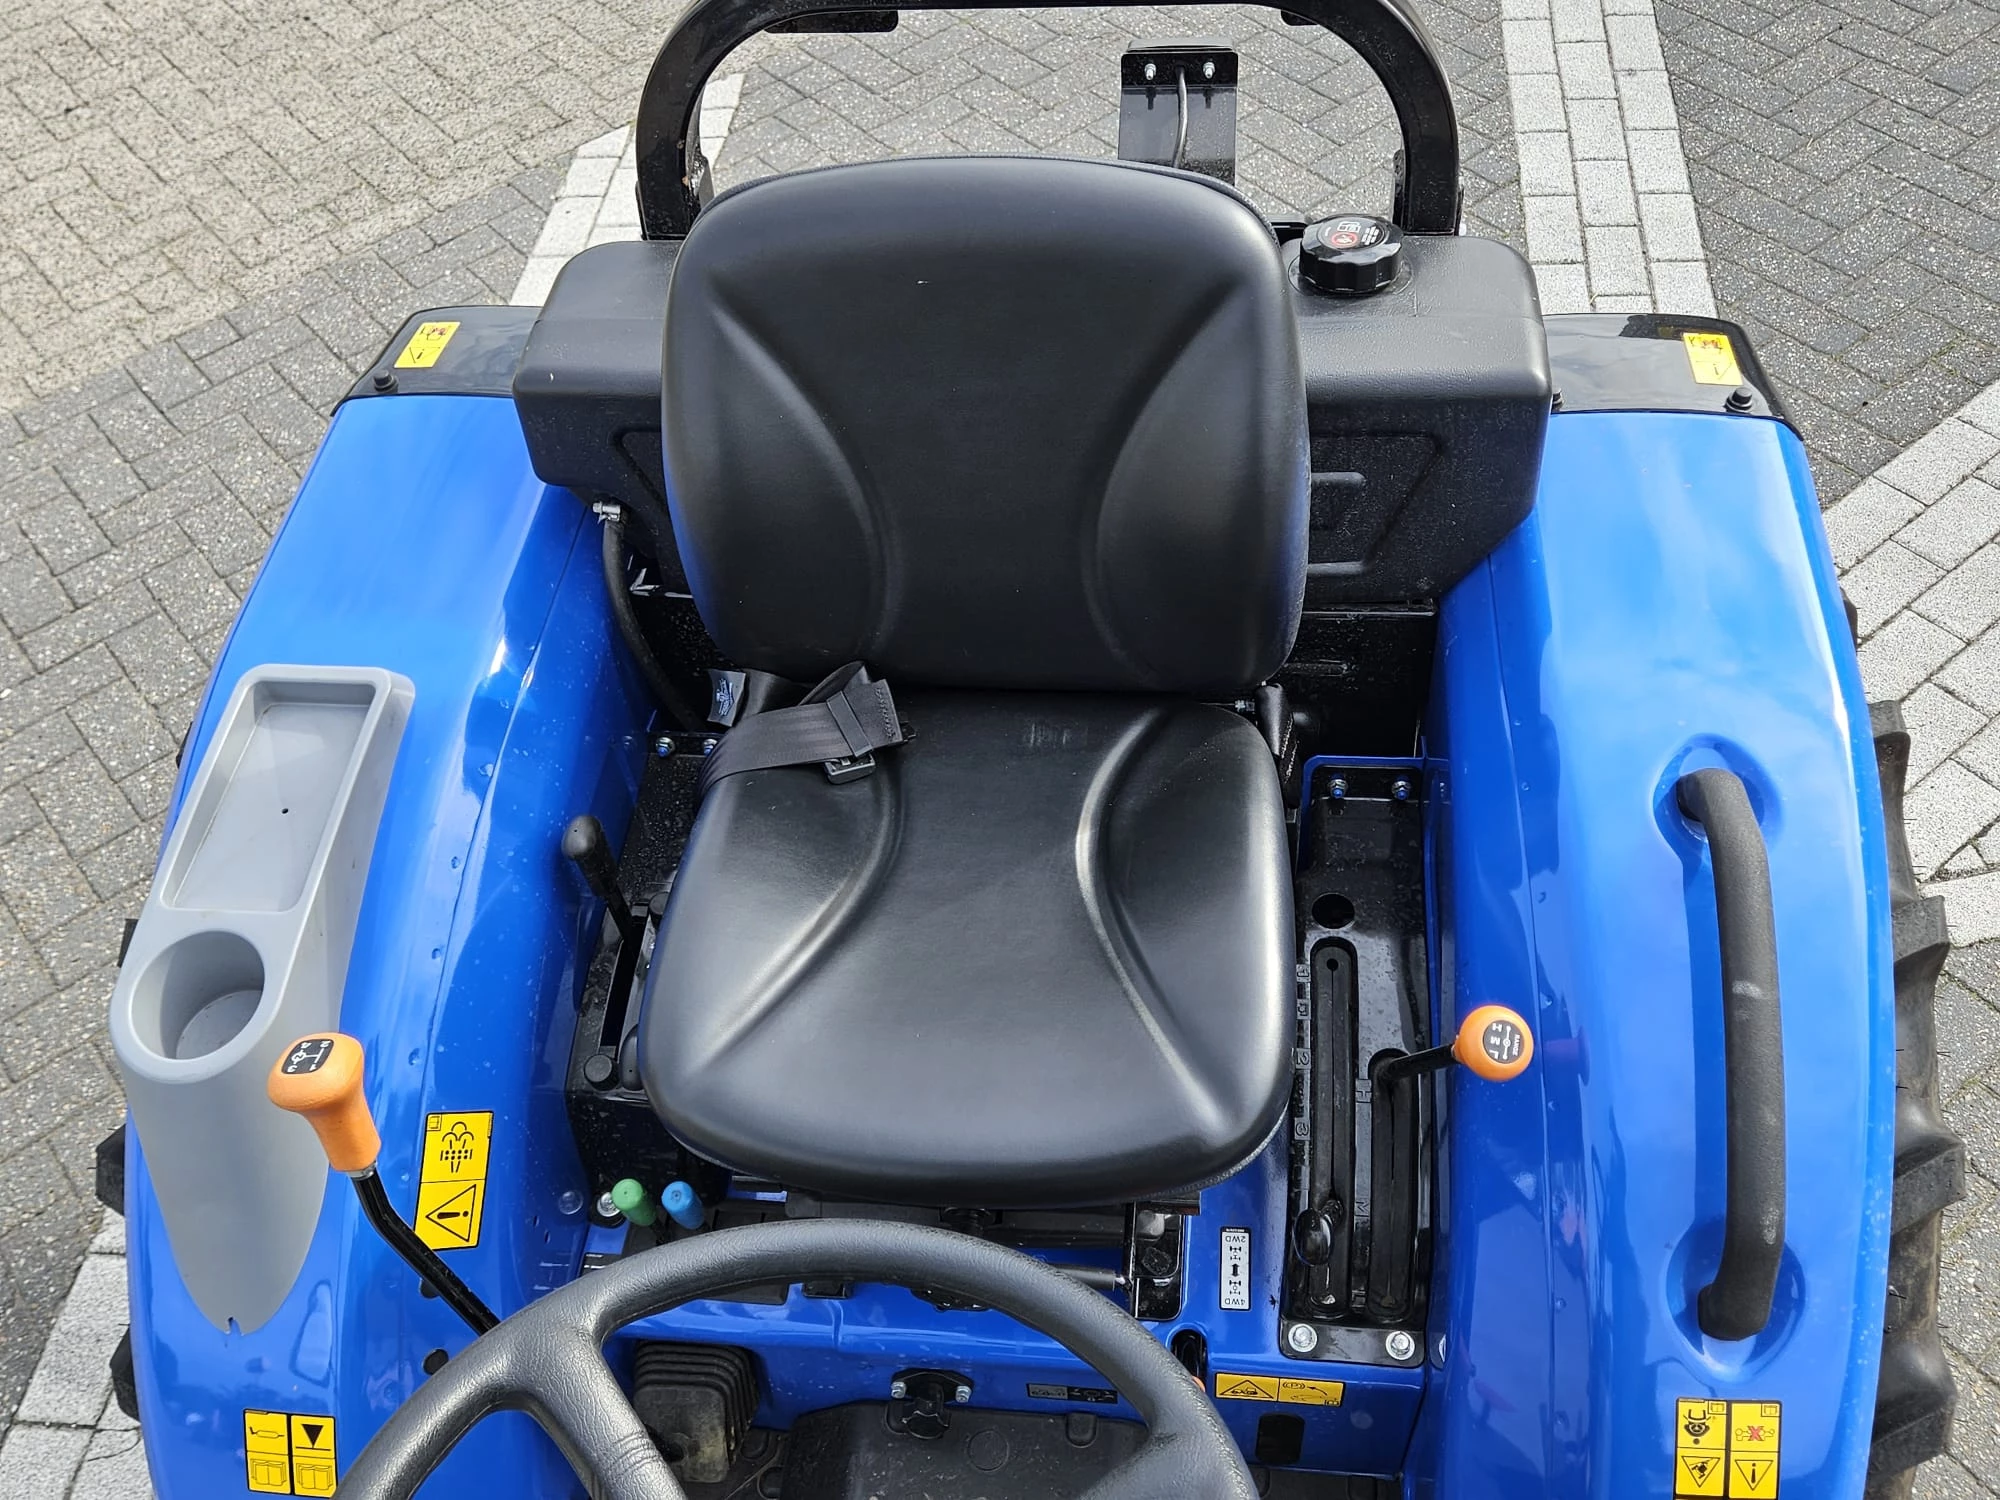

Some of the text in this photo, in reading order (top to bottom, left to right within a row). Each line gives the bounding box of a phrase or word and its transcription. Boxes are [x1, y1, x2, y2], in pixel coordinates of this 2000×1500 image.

[1492, 1023, 1502, 1032] H
[1490, 1036, 1500, 1045] M
[1512, 1034, 1520, 1056] RANGE
[1296, 1052, 1310, 1066] 2
[1489, 1049, 1499, 1060] L
[1295, 1123, 1310, 1137] 3
[1224, 1235, 1247, 1244] 2WD
[1224, 1297, 1246, 1306] 4WD
